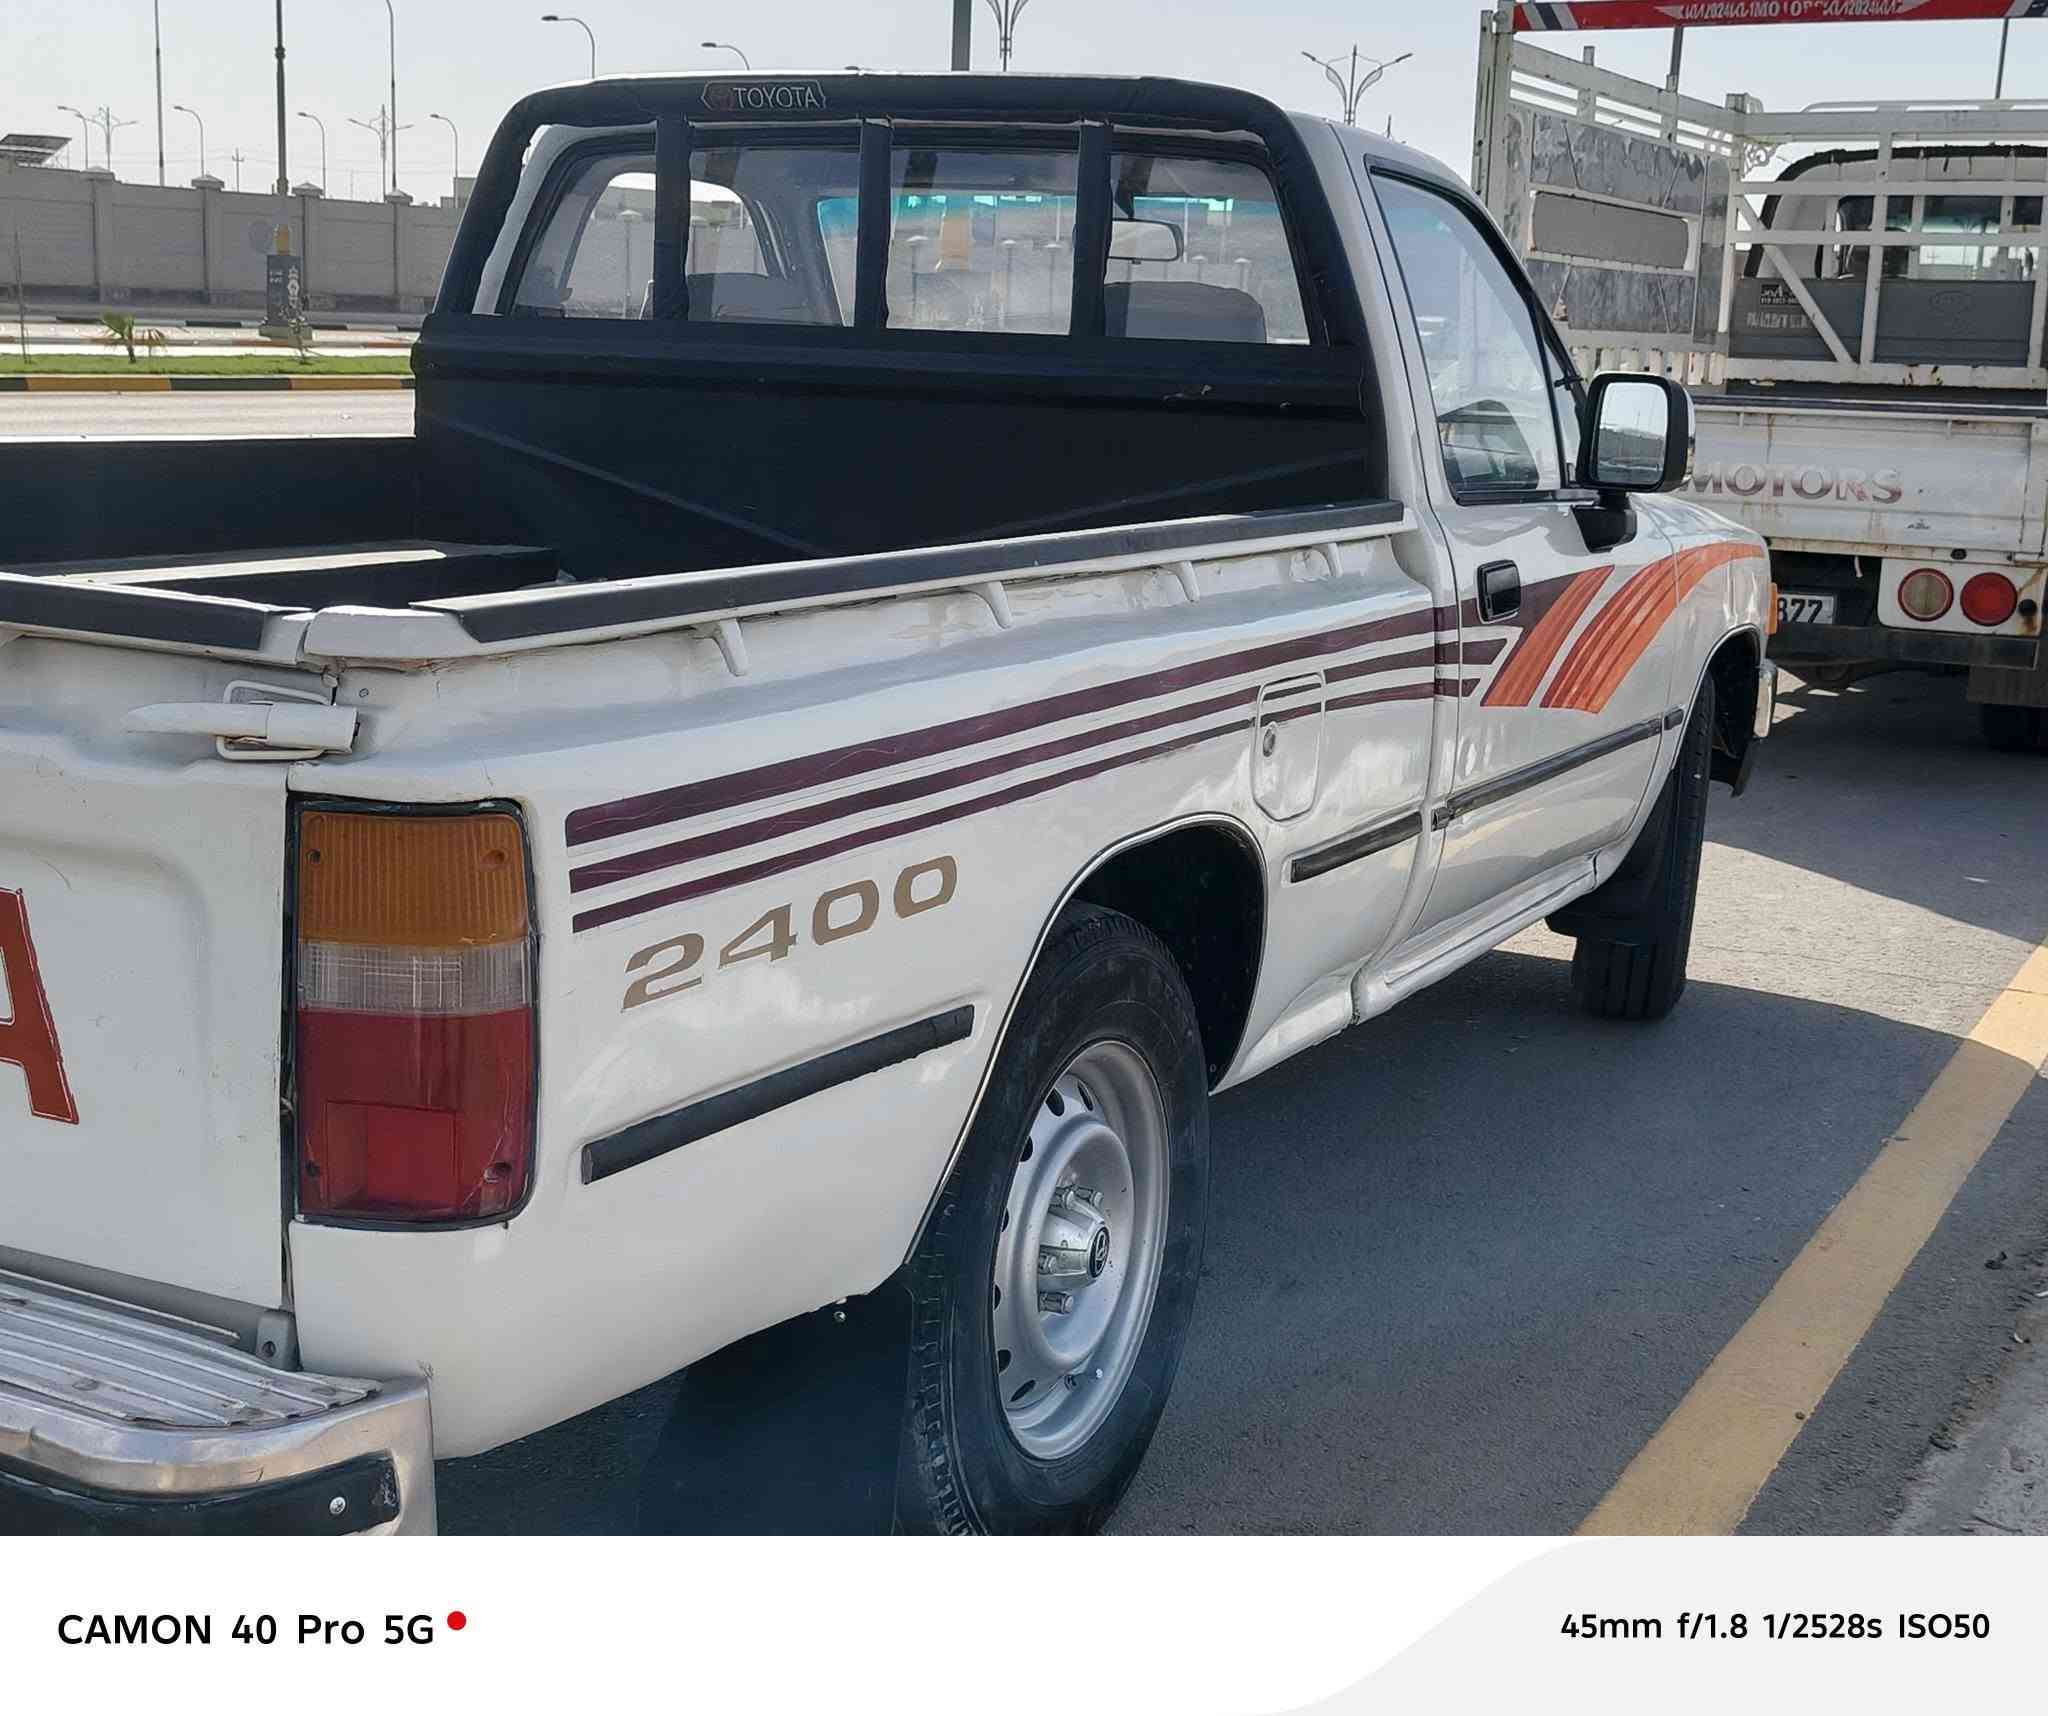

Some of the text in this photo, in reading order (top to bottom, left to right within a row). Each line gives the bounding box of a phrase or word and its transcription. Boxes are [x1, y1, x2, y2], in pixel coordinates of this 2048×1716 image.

[733, 86, 821, 109] TOYOTA
[1680, 462, 1903, 504] MOTORS
[621, 855, 957, 1013] 2400
